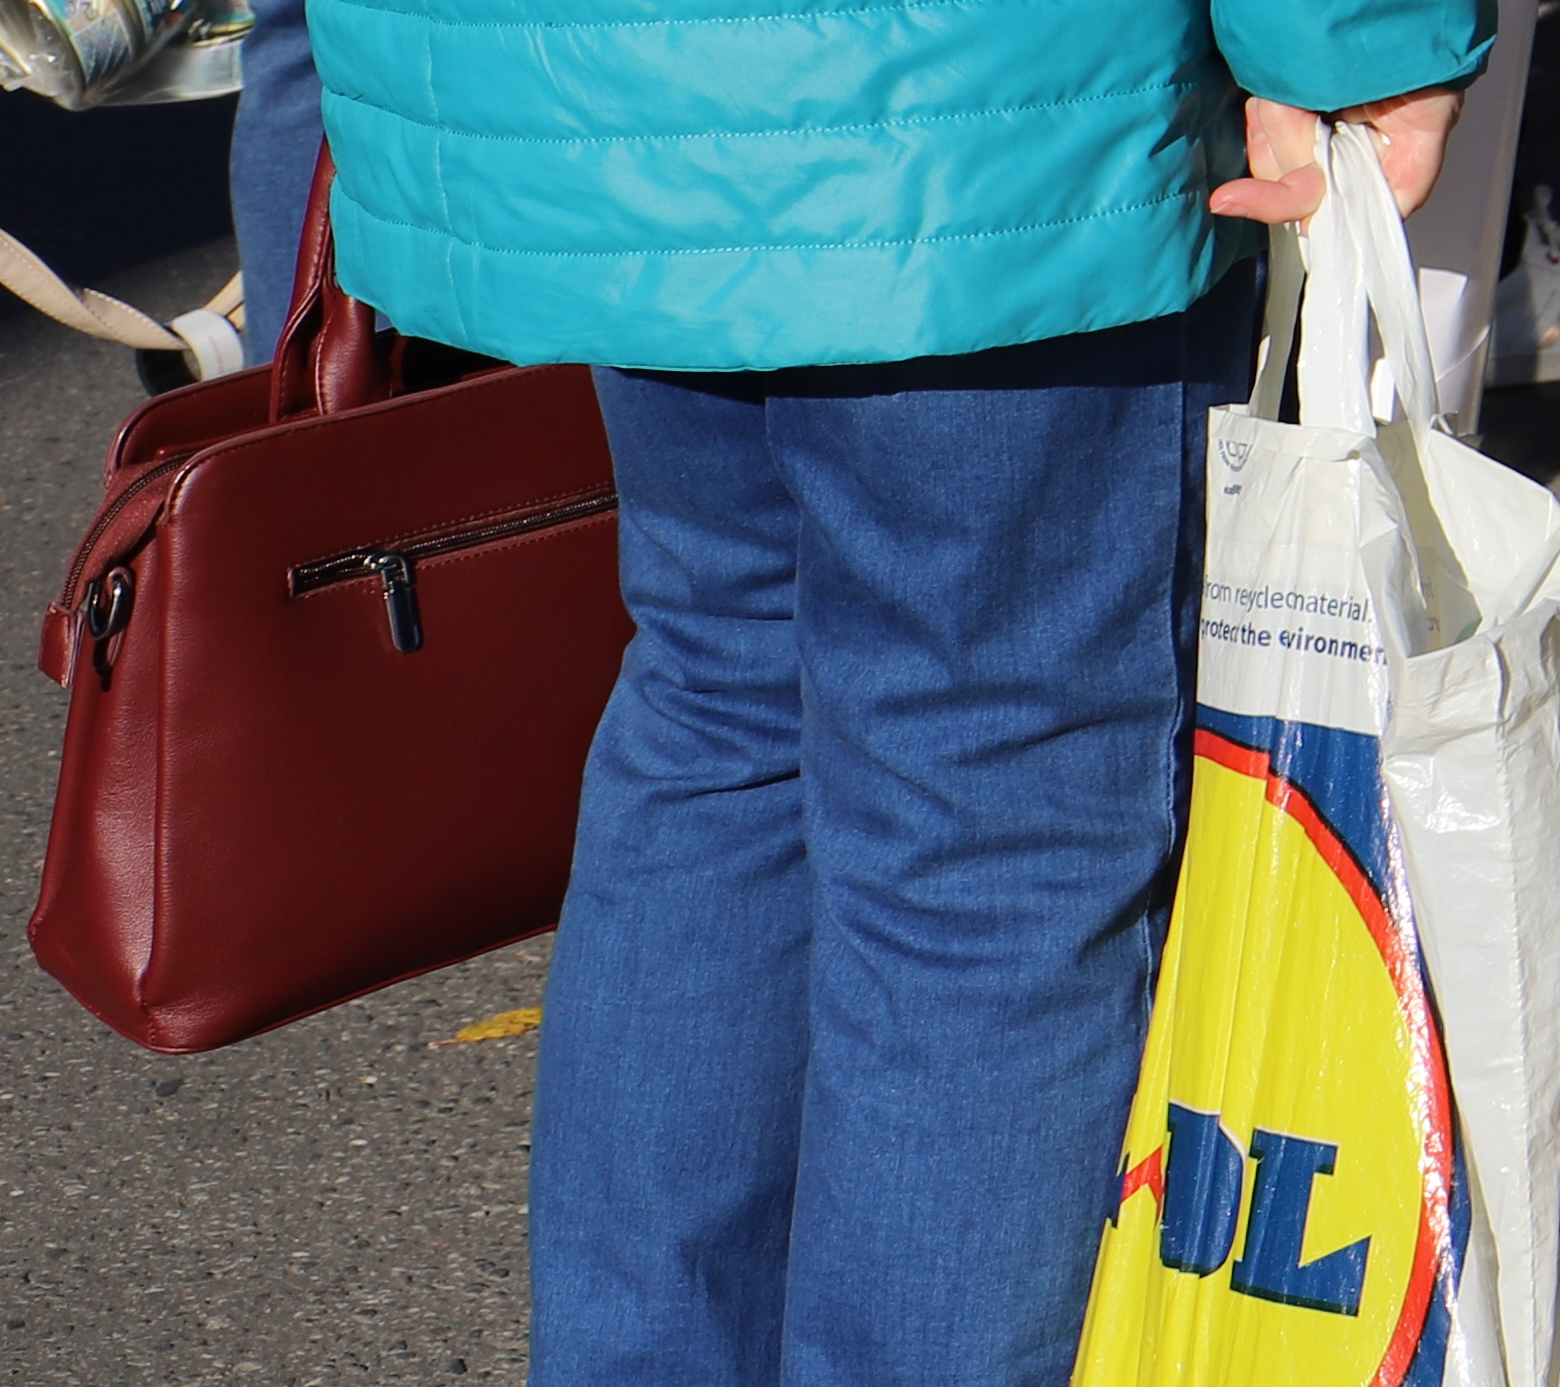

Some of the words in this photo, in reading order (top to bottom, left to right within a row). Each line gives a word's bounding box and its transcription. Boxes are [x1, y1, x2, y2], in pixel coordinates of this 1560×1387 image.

[1201, 617, 1240, 643] rotec
[1240, 621, 1273, 647] the
[1107, 1098, 1373, 1318] DL
